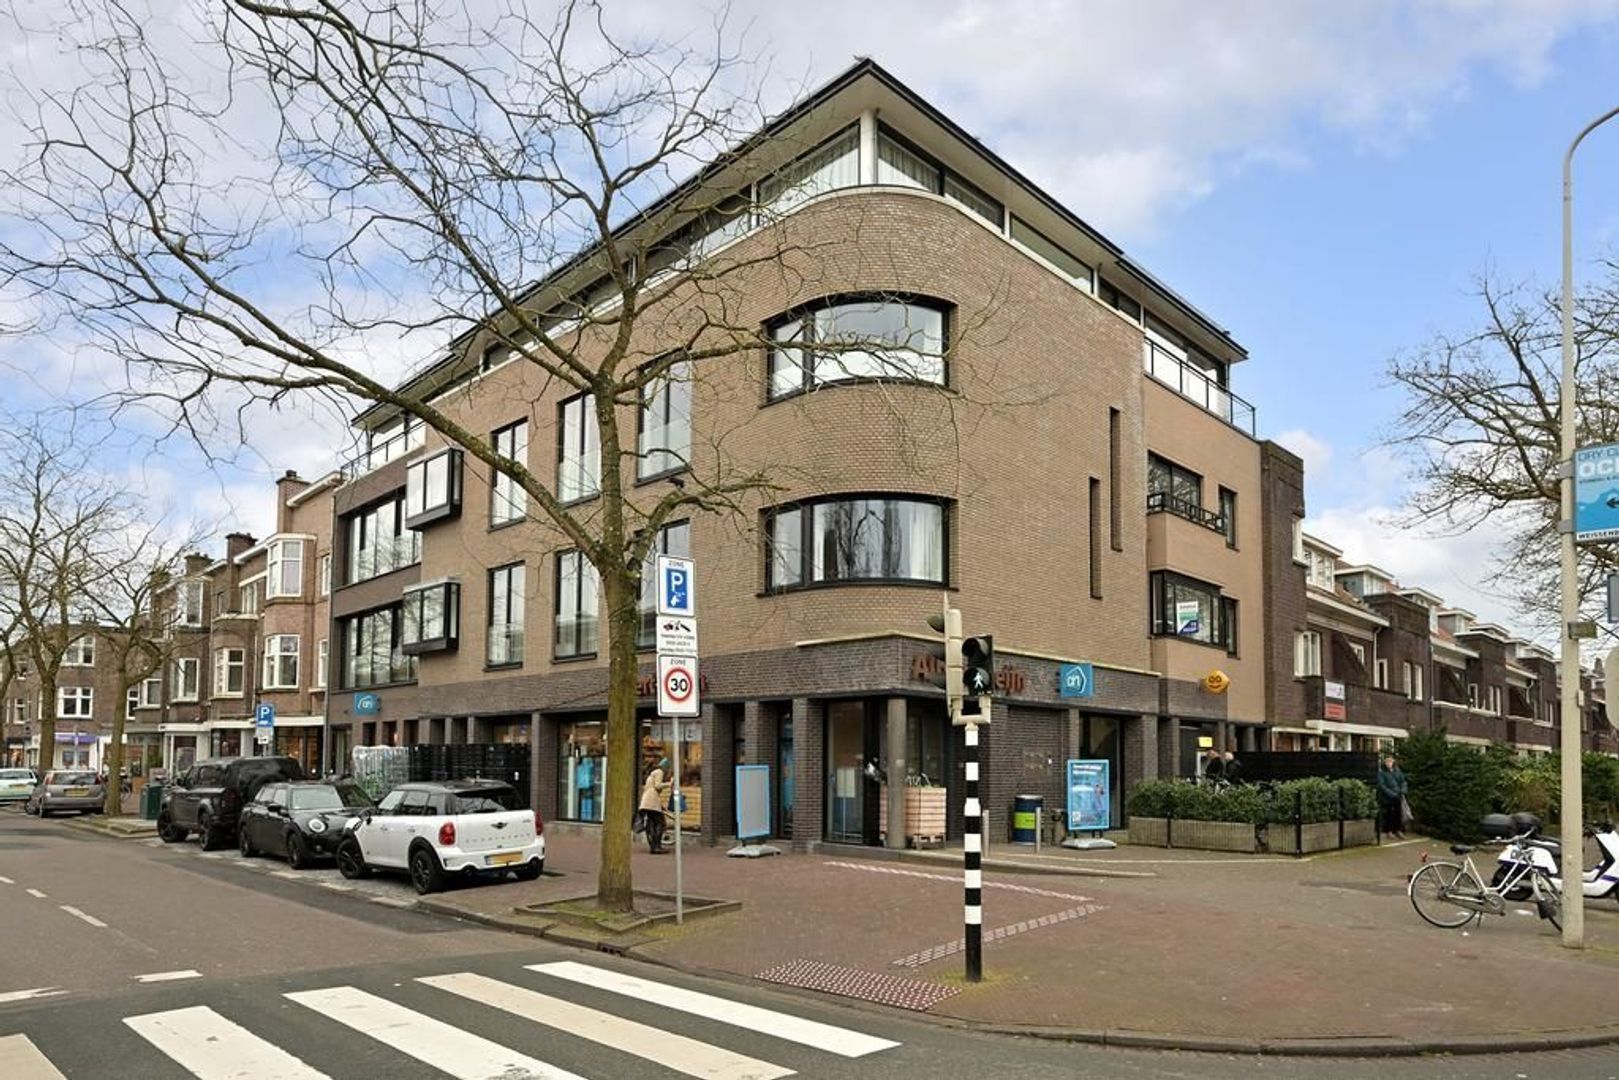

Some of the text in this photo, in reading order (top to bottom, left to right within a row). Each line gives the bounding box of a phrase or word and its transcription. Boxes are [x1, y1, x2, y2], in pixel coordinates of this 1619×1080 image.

[668, 559, 684, 568] ZONE
[671, 571, 683, 592] P
[670, 658, 686, 666] ZONE
[670, 678, 688, 692] 30
[261, 706, 271, 719] P
